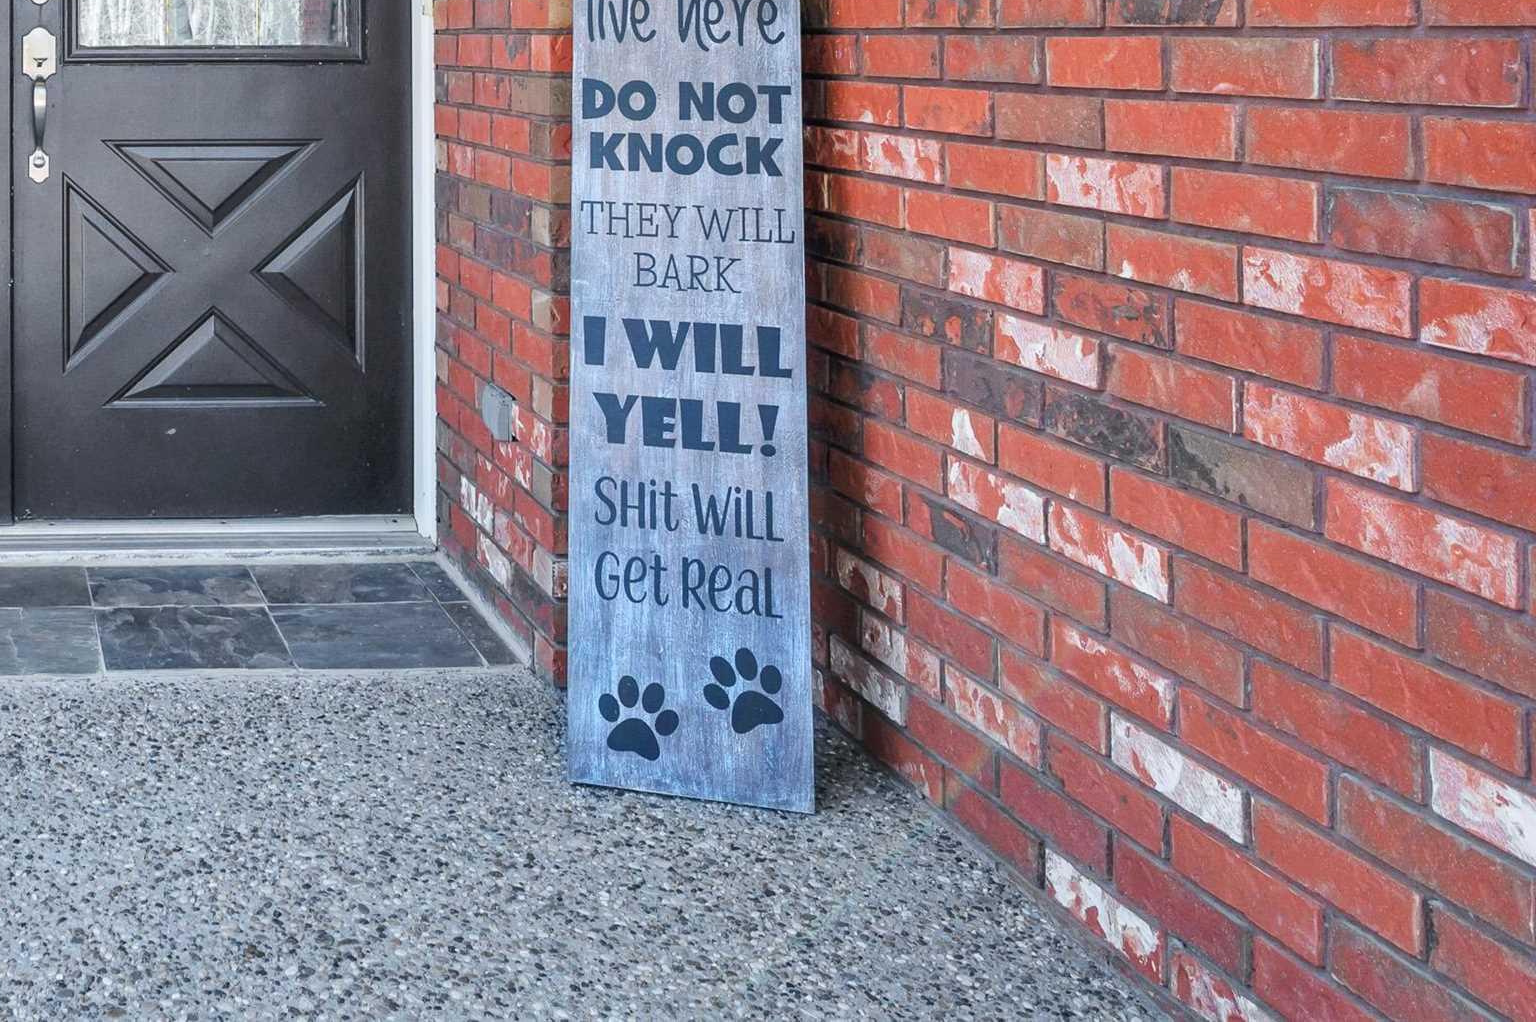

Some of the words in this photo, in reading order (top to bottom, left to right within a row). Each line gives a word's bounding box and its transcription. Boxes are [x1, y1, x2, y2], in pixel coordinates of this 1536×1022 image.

[582, 78, 657, 121] DO
[679, 81, 791, 124] NOT
[590, 132, 783, 177] KNOCK
[581, 201, 686, 238] THEY
[692, 204, 796, 244] WILL
[632, 252, 741, 294] BARK
[583, 316, 606, 366] I
[621, 318, 792, 378] WILL
[592, 393, 780, 457] YELL!
[594, 551, 670, 606] Get
